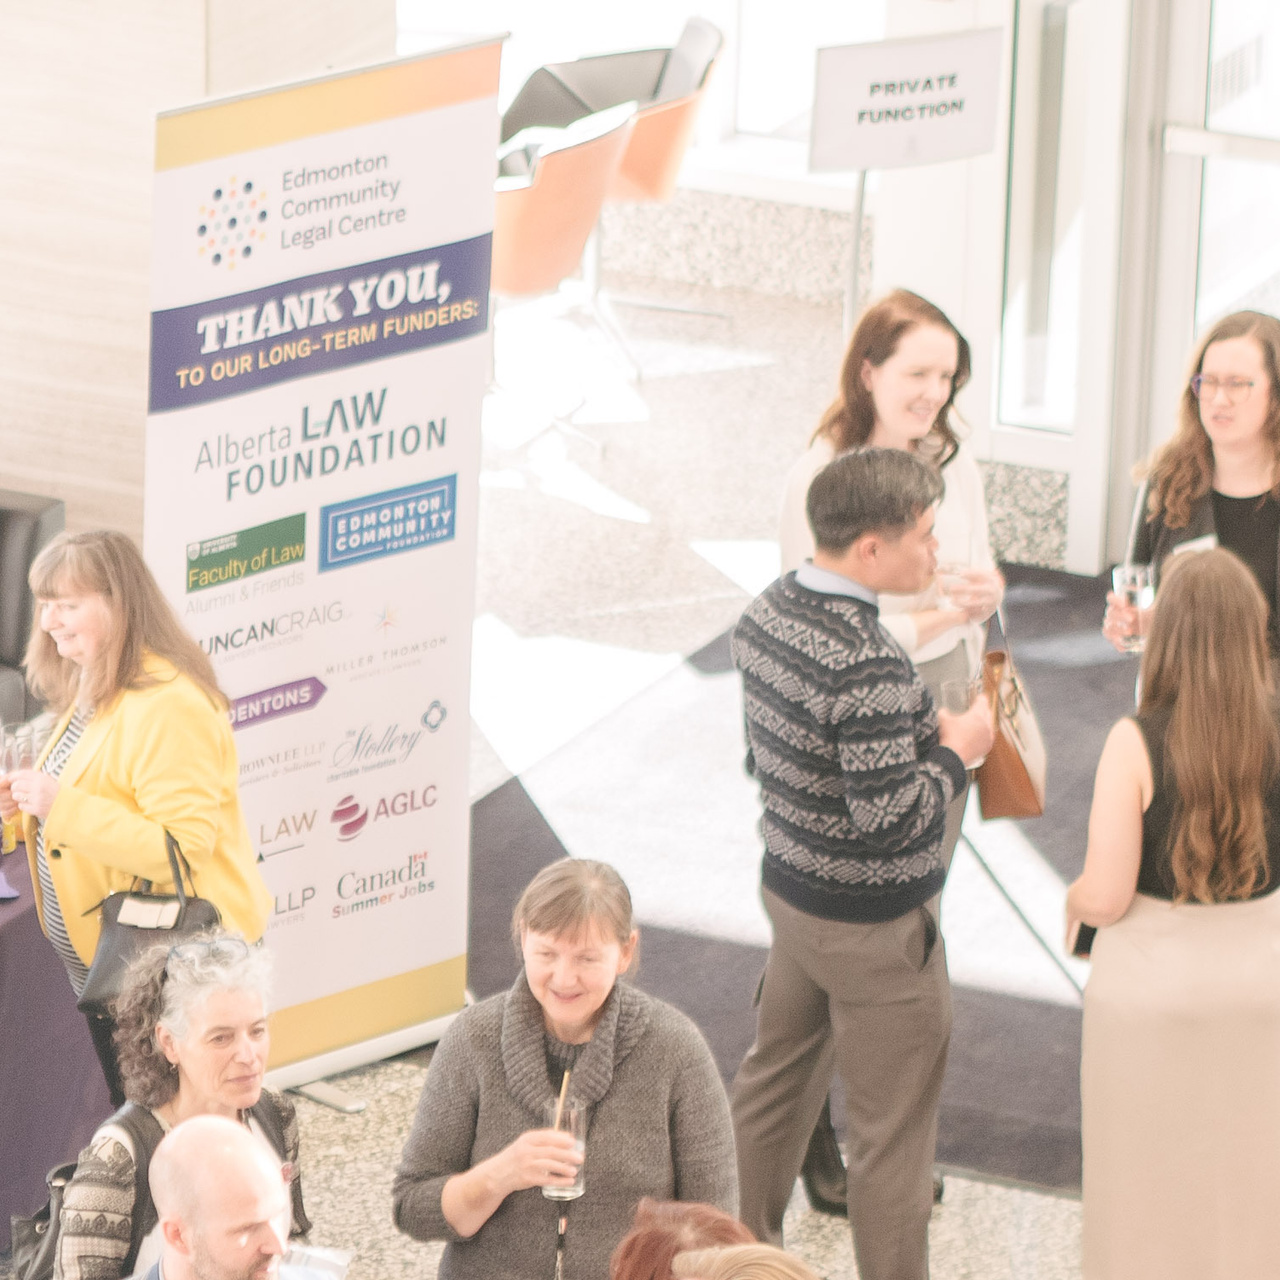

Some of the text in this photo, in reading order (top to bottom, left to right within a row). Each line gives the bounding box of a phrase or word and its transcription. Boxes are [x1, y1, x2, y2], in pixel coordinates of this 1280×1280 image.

[869, 73, 958, 97] PRIVATE
[857, 98, 965, 125] FUNCTION
[282, 154, 388, 191] Edmonton
[281, 178, 401, 219] Community
[280, 206, 406, 250] Legal Centre
[197, 262, 451, 354] THANK YOU,
[176, 300, 479, 389] TO OUR LONG-TERM FUNDERS:
[194, 387, 388, 473] Alberta LAW
[227, 416, 447, 501] FOUNDATION
[336, 510, 452, 551] COMMUNITY
[337, 495, 440, 534] EDMONTON
[188, 543, 305, 588] Faculty of Law
[185, 590, 235, 616] Alumni
[252, 570, 304, 598] Friends
[199, 600, 343, 656] UNCANCRAIG
[325, 654, 374, 676] MILLER
[382, 636, 447, 660] THOMSON
[239, 748, 299, 775] ROWNLEE
[329, 723, 425, 768] Stollery
[373, 784, 438, 821] AGLC
[260, 809, 319, 845] LAW
[337, 854, 427, 900] Canada
[274, 886, 316, 916] LLP
[332, 880, 435, 919] Summer Jobs
